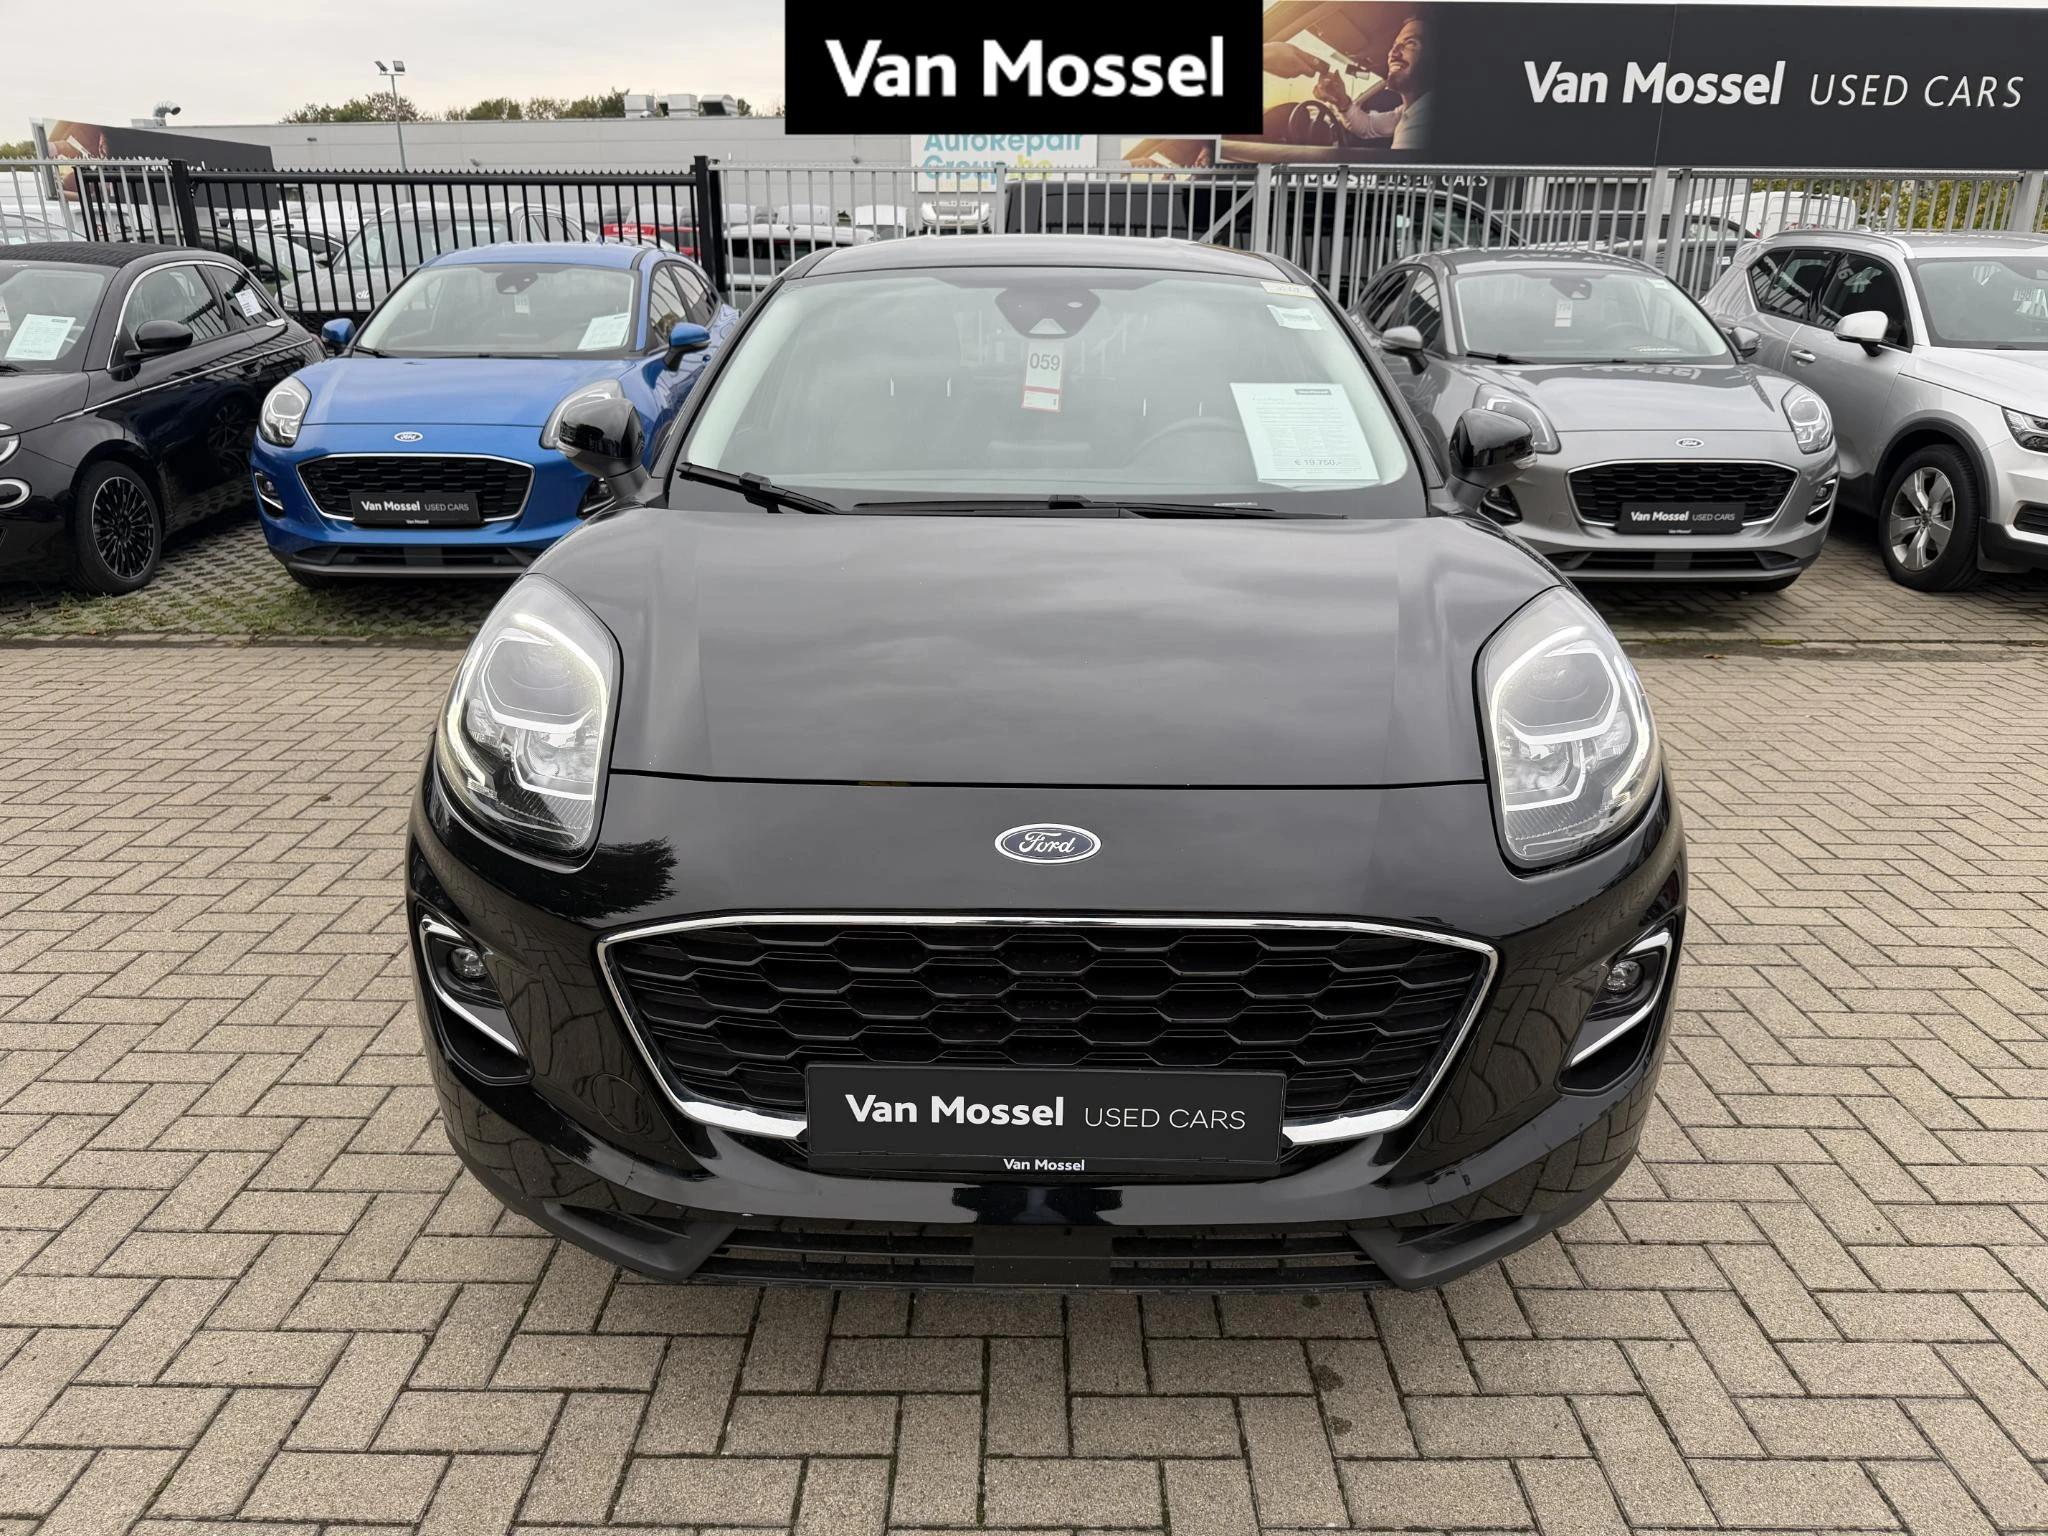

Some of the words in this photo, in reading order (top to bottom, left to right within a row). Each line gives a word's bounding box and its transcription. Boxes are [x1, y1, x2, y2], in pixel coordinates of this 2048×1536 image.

[1523, 60, 1609, 104] Van
[1622, 60, 1786, 106] Mossel
[1810, 73, 1909, 107] USED
[1924, 75, 2025, 109] CARS
[1029, 352, 1061, 371] 059
[361, 501, 382, 511] Van
[384, 501, 420, 511] Mossel
[424, 503, 447, 511] USED
[447, 503, 470, 511] CARS
[1631, 511, 1651, 521] Van
[1652, 511, 1690, 521] Mossel
[1692, 513, 1714, 521] USED
[1714, 513, 1736, 521] CARS
[1018, 831, 1077, 853] Ford
[844, 1093, 918, 1124] Van
[931, 1095, 1064, 1127] Mossel
[1085, 1106, 1160, 1129] USED
[1169, 1107, 1247, 1131] CARS
[1003, 1158, 1031, 1171] Van
[1035, 1158, 1086, 1172] Mossel
